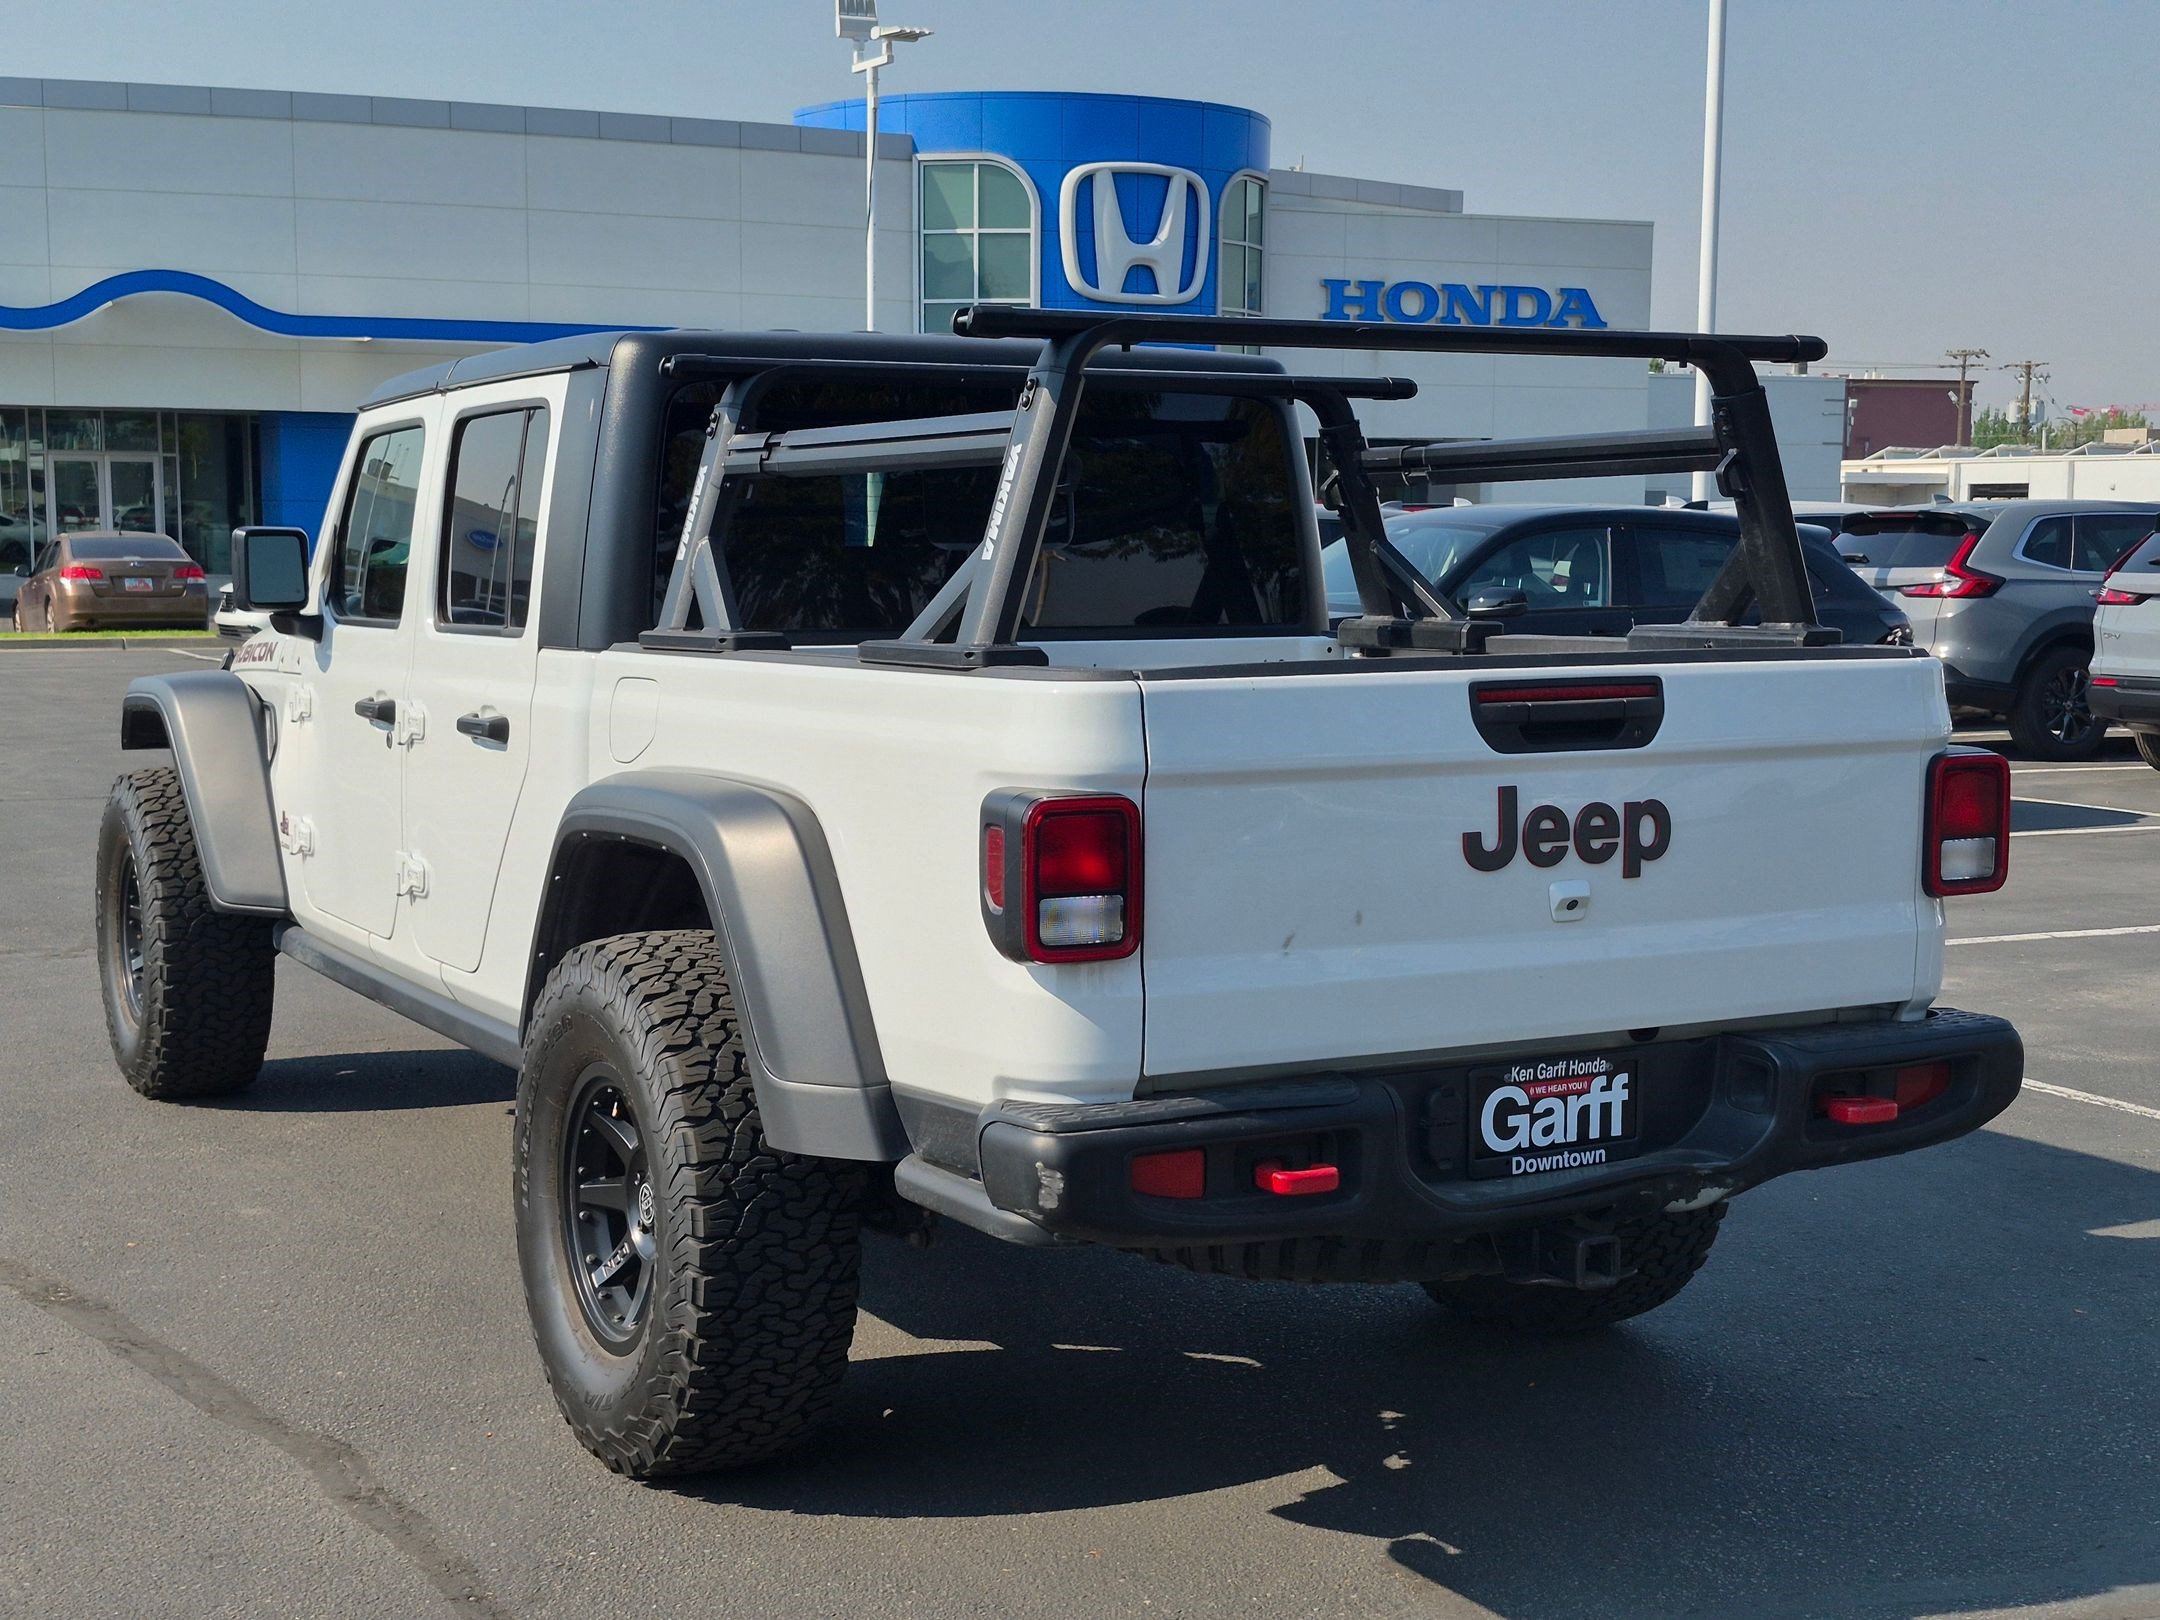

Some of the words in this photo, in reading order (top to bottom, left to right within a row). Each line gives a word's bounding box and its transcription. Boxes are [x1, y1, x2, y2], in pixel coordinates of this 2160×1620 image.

[1321, 278, 1608, 328] HONDA
[675, 464, 709, 561] YAKIMA
[981, 443, 1022, 560] YAKIMA
[1462, 785, 1672, 879] Jeep
[1511, 1065, 1534, 1083] Ken
[1537, 1061, 1567, 1079] Garff
[1569, 1056, 1607, 1076] Honda
[1535, 1085, 1547, 1094] WE
[1548, 1083, 1568, 1093] HEAR
[1569, 1082, 1583, 1091] YOU
[1480, 1072, 1629, 1152] Garff
[1511, 1148, 1606, 1175] Downtown
